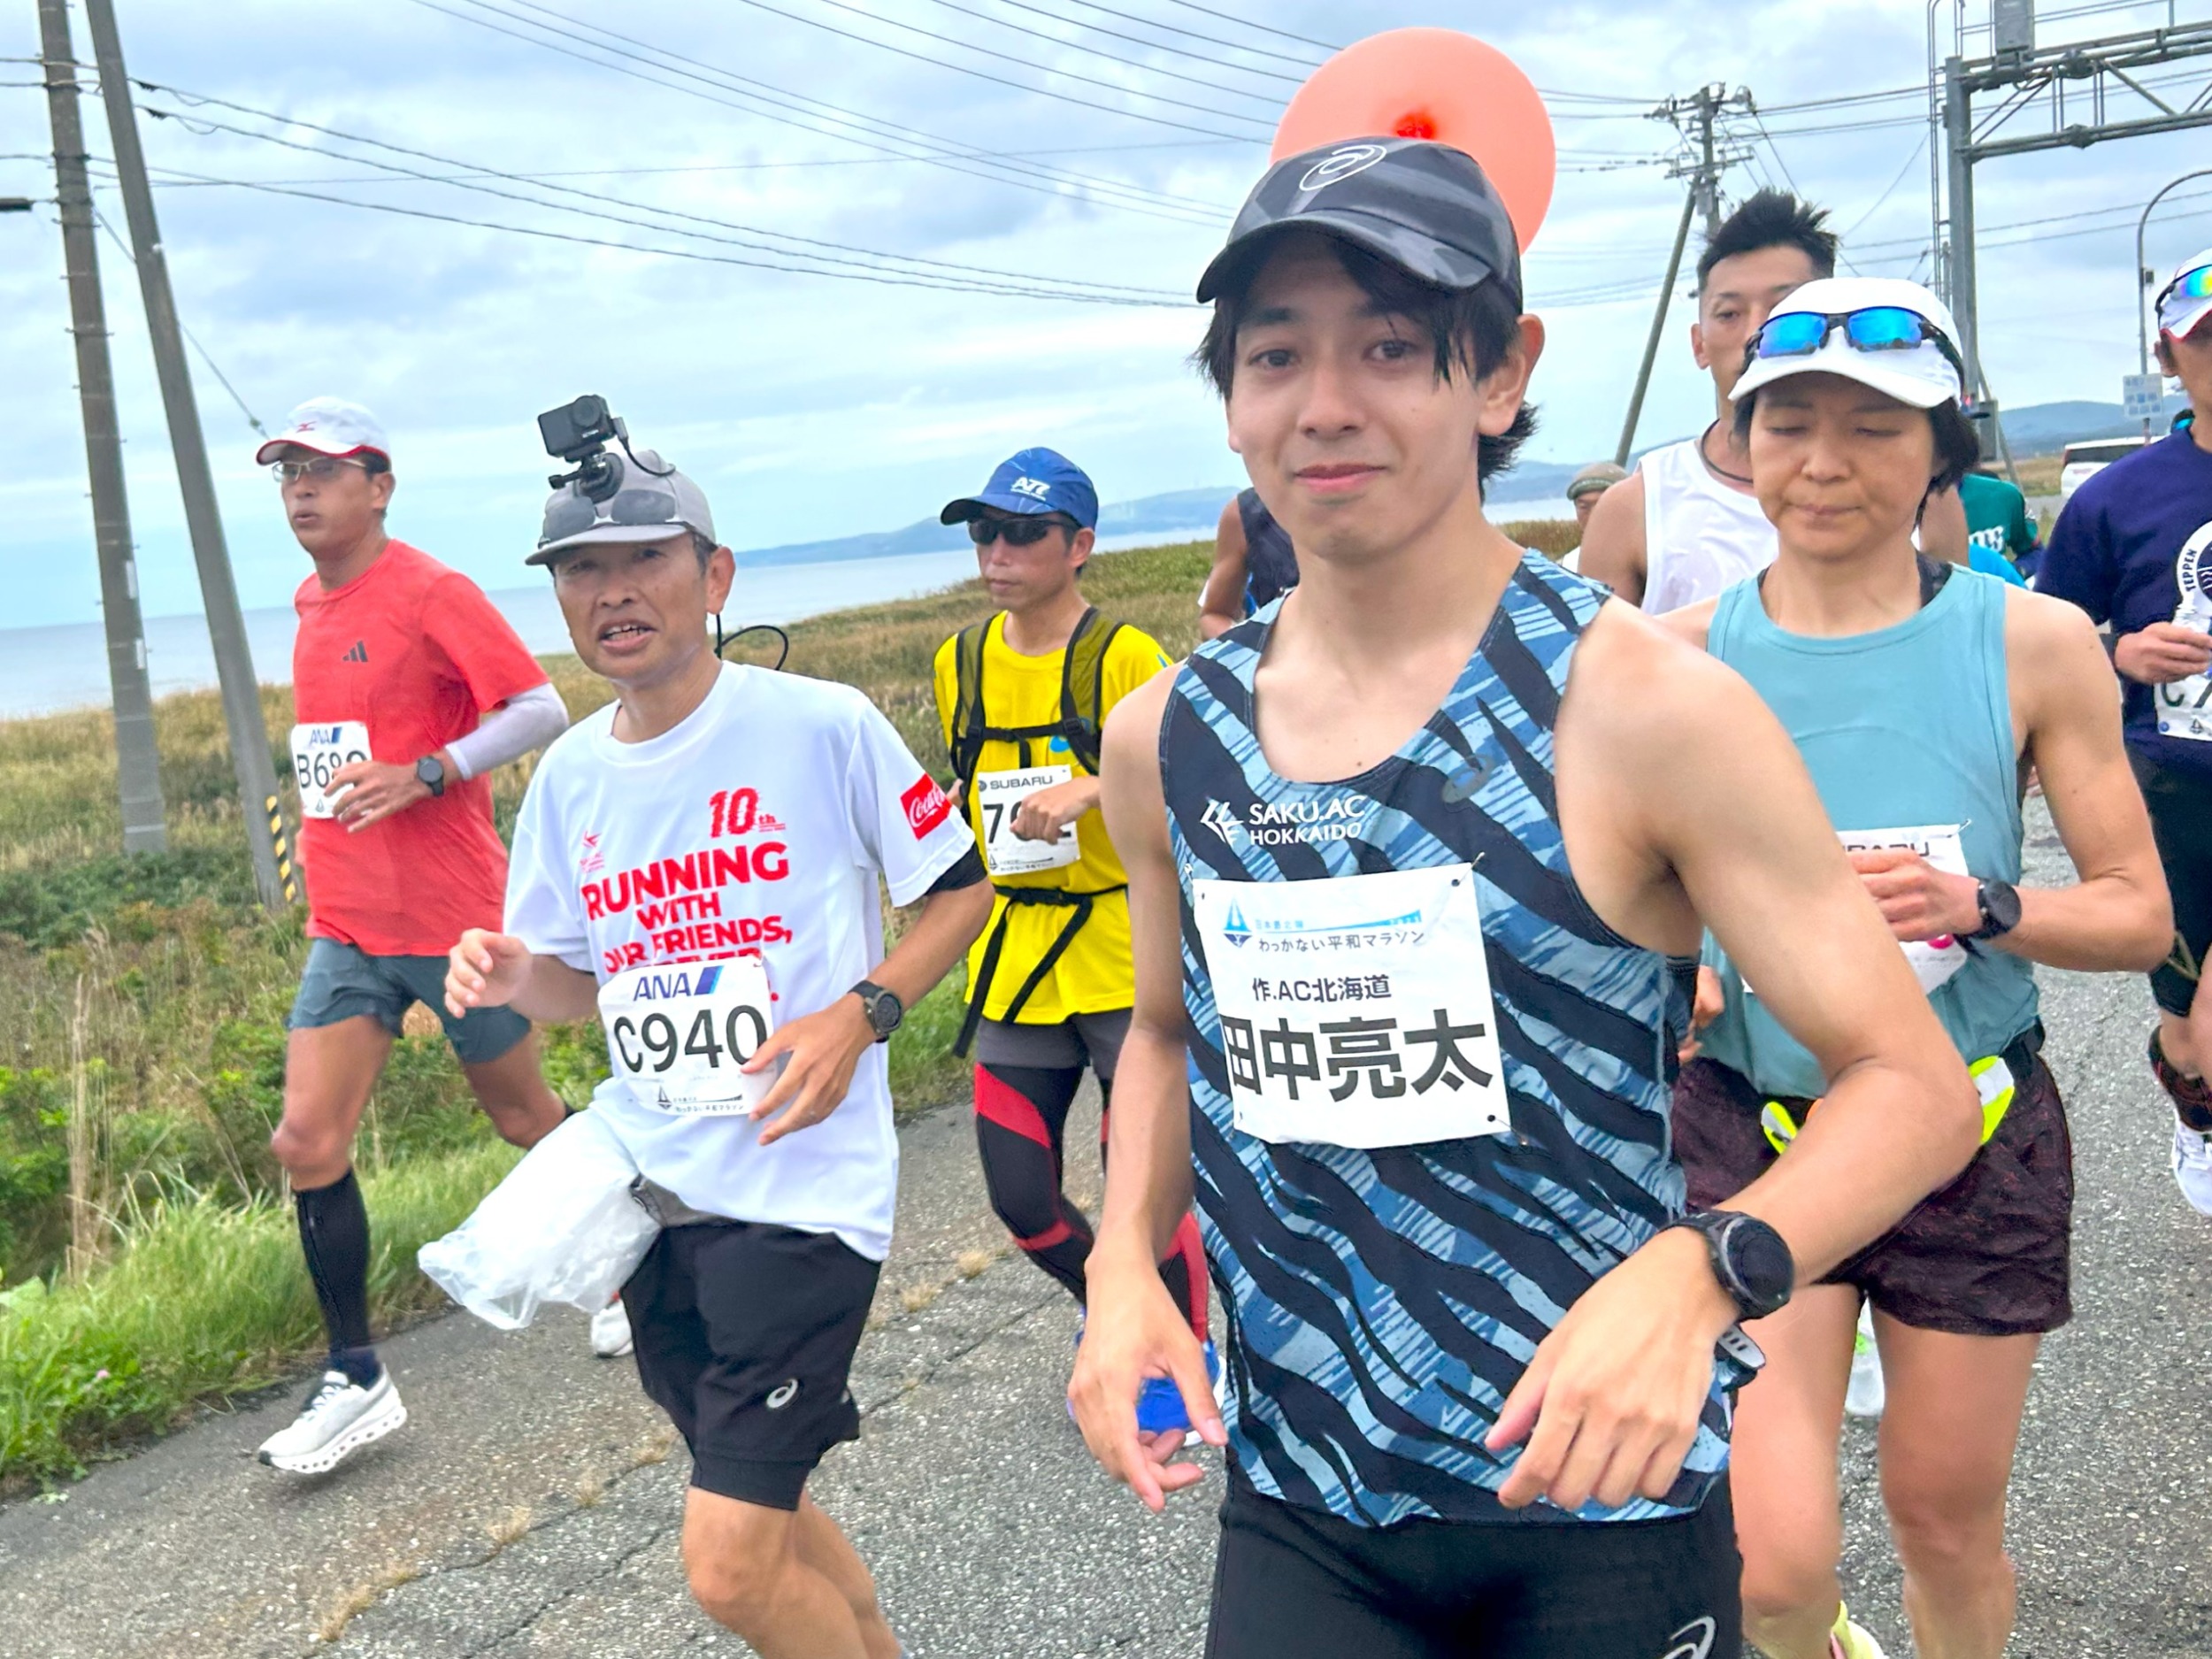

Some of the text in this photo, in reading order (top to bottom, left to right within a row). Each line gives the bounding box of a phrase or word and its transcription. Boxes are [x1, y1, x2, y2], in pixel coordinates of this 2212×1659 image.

[2182, 549, 2197, 592] TEPPEN
[309, 729, 330, 746] ANA
[990, 775, 1053, 789] SUBARU
[1249, 795, 1368, 826] SAKU.AC
[1250, 822, 1362, 846] HOKKAIDO
[581, 841, 789, 921] RUNNING
[636, 892, 721, 931] WITH
[651, 915, 793, 958] FRIENDS,
[1258, 930, 1425, 952] わっかない平和マラソン
[634, 972, 691, 1002] ANA
[1252, 974, 1392, 1002] 作.AC北海道
[614, 1004, 768, 1072] C940
[1218, 1008, 1494, 1102] 田中亮太
